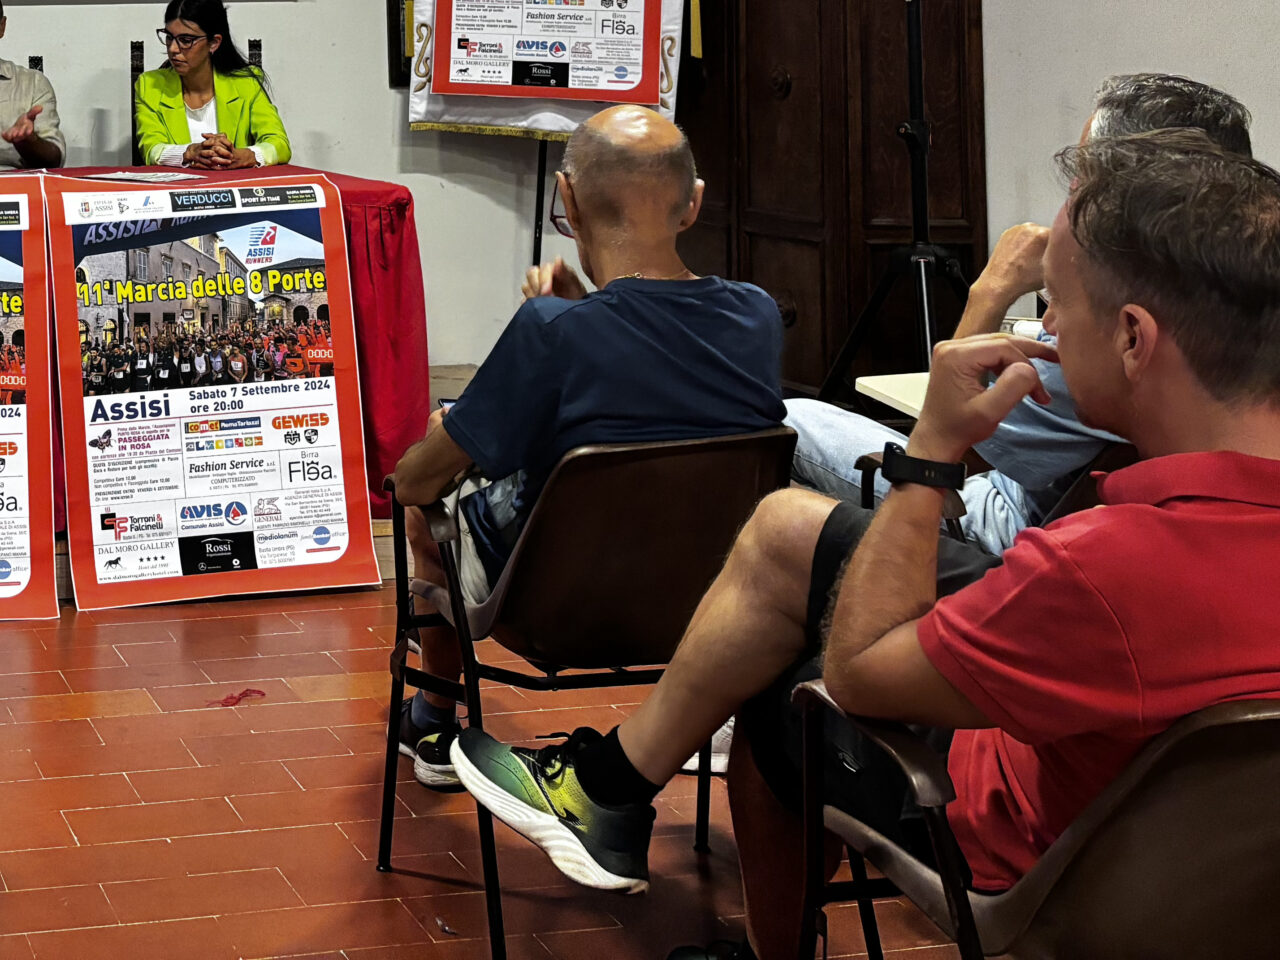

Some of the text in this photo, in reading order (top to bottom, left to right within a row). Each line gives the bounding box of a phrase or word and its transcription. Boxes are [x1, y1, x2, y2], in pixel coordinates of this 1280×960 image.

[526, 12, 584, 21] Fashion Service
[516, 40, 548, 50] AVIS
[532, 67, 551, 75] Rossi
[175, 193, 232, 205] VERDUCCI
[247, 247, 274, 257] ASSISI
[117, 280, 187, 304] Marcia
[192, 273, 245, 298] delle
[250, 272, 262, 294] 8
[269, 268, 325, 292] Porte
[189, 380, 330, 401] Sabato 7 Settembre 2024
[90, 393, 170, 422] Assisi
[190, 400, 244, 413] ore 20:00
[118, 434, 170, 443] PASSEGGIATA
[131, 442, 151, 450] ROSA
[189, 458, 264, 473] Fashion Service
[180, 504, 223, 519] AVIS
[129, 514, 155, 524] Torroni
[130, 522, 163, 532] Falcinelli
[98, 541, 175, 555] DAL MORO GALLERY
[206, 542, 231, 553] Rossi
